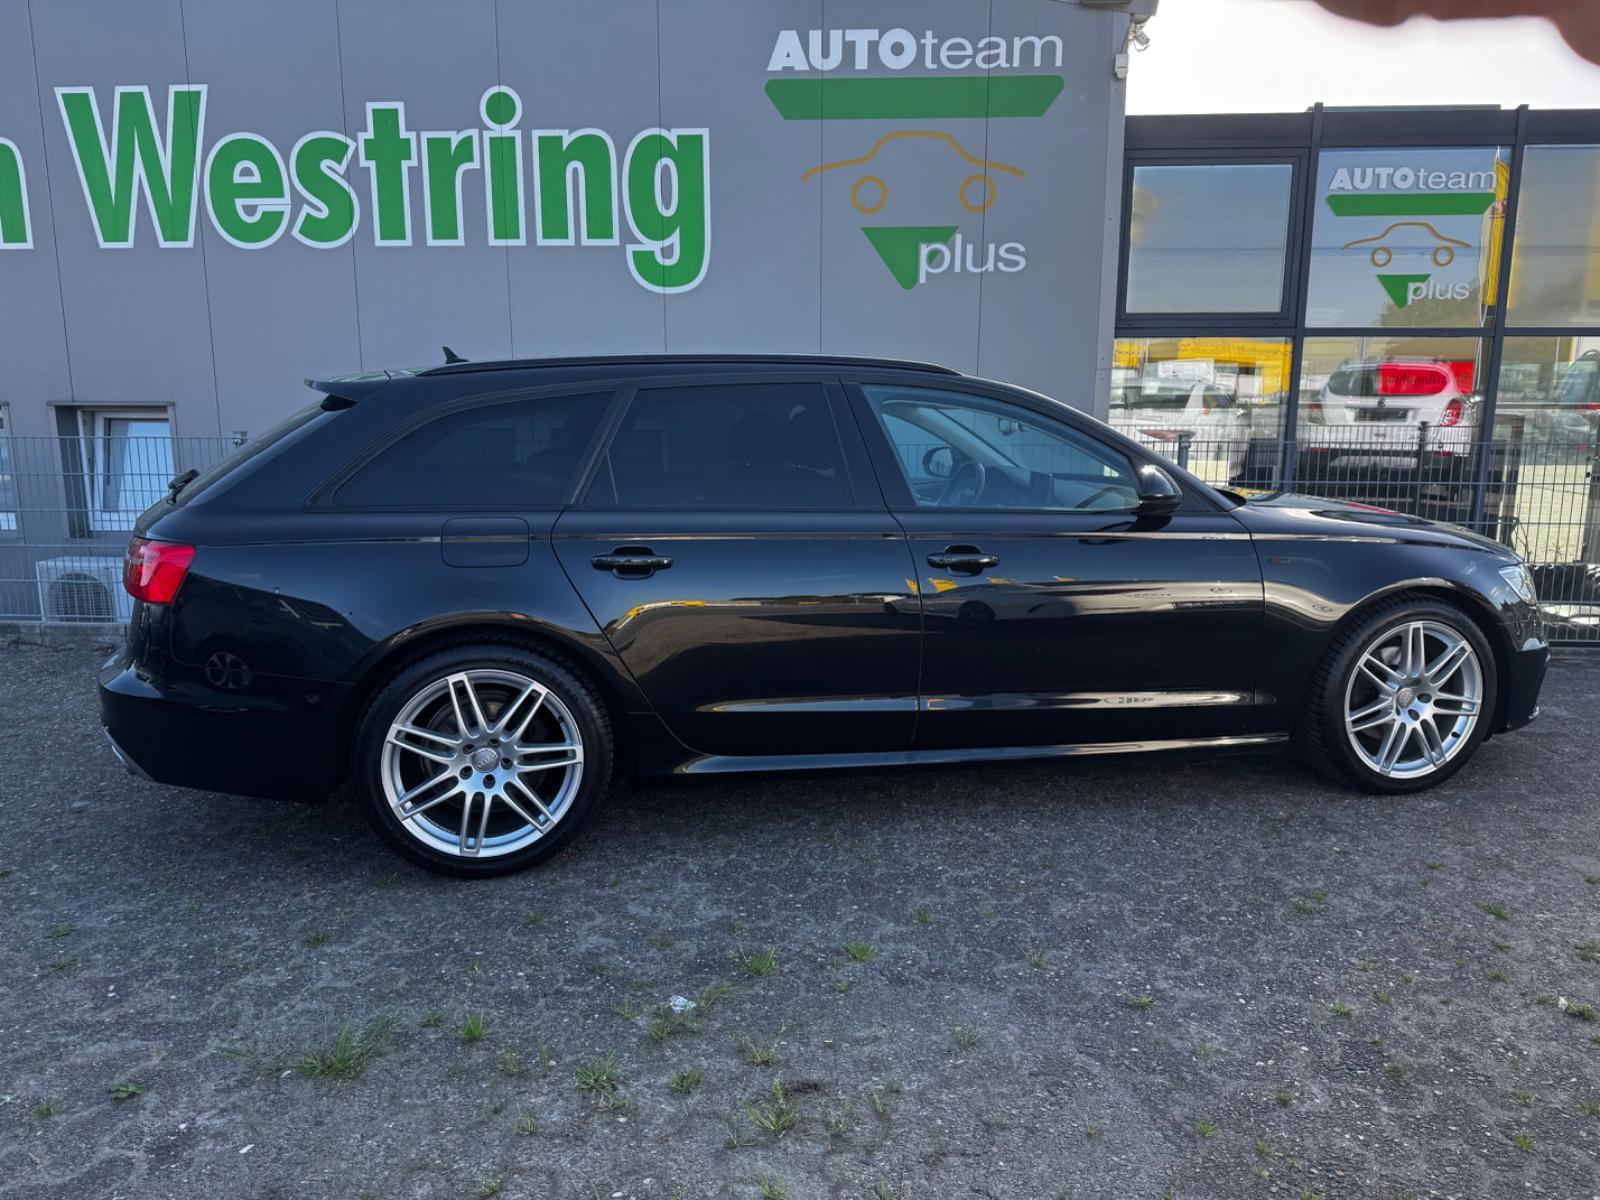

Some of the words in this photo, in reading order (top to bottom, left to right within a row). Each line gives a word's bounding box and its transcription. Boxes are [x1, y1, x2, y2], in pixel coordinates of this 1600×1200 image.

[766, 28, 1064, 71] AUTOteam
[54, 84, 711, 294] Westring
[1328, 167, 1497, 191] AUTOteam
[918, 233, 1027, 284] plus
[1407, 277, 1470, 305] plus
